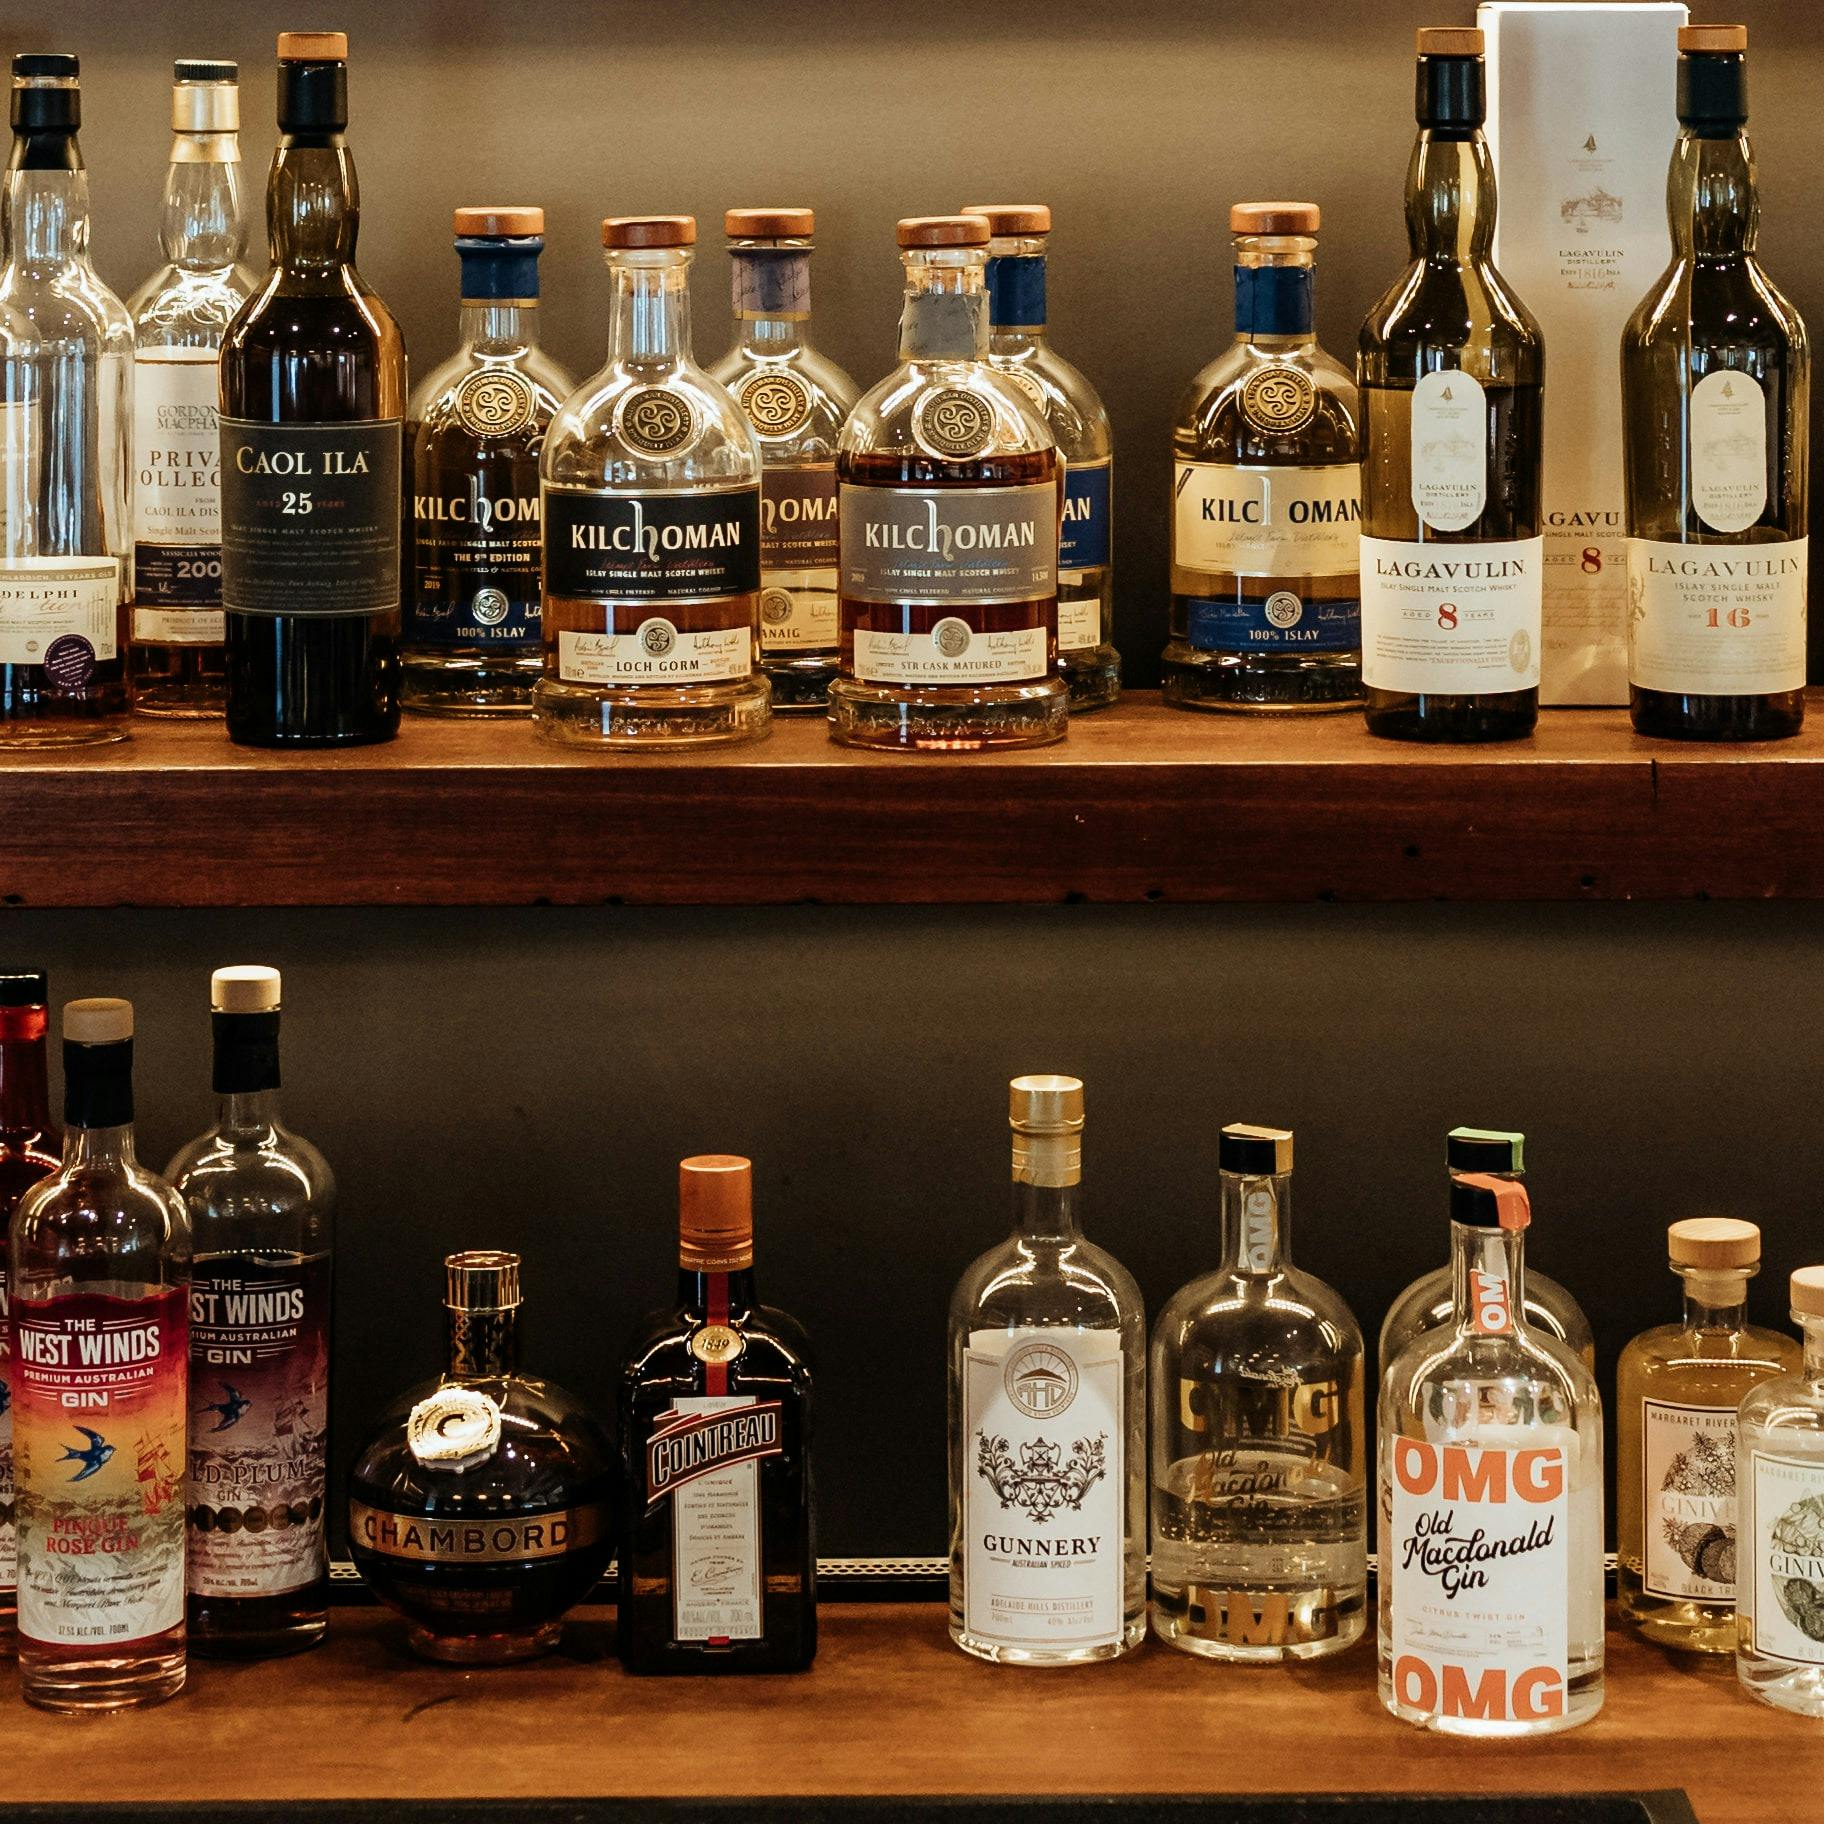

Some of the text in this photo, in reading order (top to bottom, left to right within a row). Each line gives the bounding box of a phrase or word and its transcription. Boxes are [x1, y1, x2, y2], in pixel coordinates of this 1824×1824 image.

[236, 446, 369, 476] CAOL ILA
[282, 491, 313, 515] 25
[1376, 559, 1525, 579] LAGAVULIN
[1649, 556, 1799, 576] LAGAVULIN
[615, 659, 700, 673] LOCH GORM
[1247, 1192, 1271, 1262] OMG
[20, 1327, 159, 1364] WEST WINDS
[24, 1368, 154, 1383] PREMIUM AUSTRALIAN
[61, 1390, 108, 1407] GIN
[652, 1415, 774, 1487] COINTREAU
[1394, 1438, 1562, 1503] OMG
[364, 1516, 567, 1554] CHAMBORD
[1416, 1511, 1454, 1537] Old
[984, 1535, 1100, 1557] GUNNERY
[1403, 1515, 1554, 1578] Macdonald
[1441, 1565, 1488, 1600] Gin
[1395, 1657, 1562, 1719] OMG
